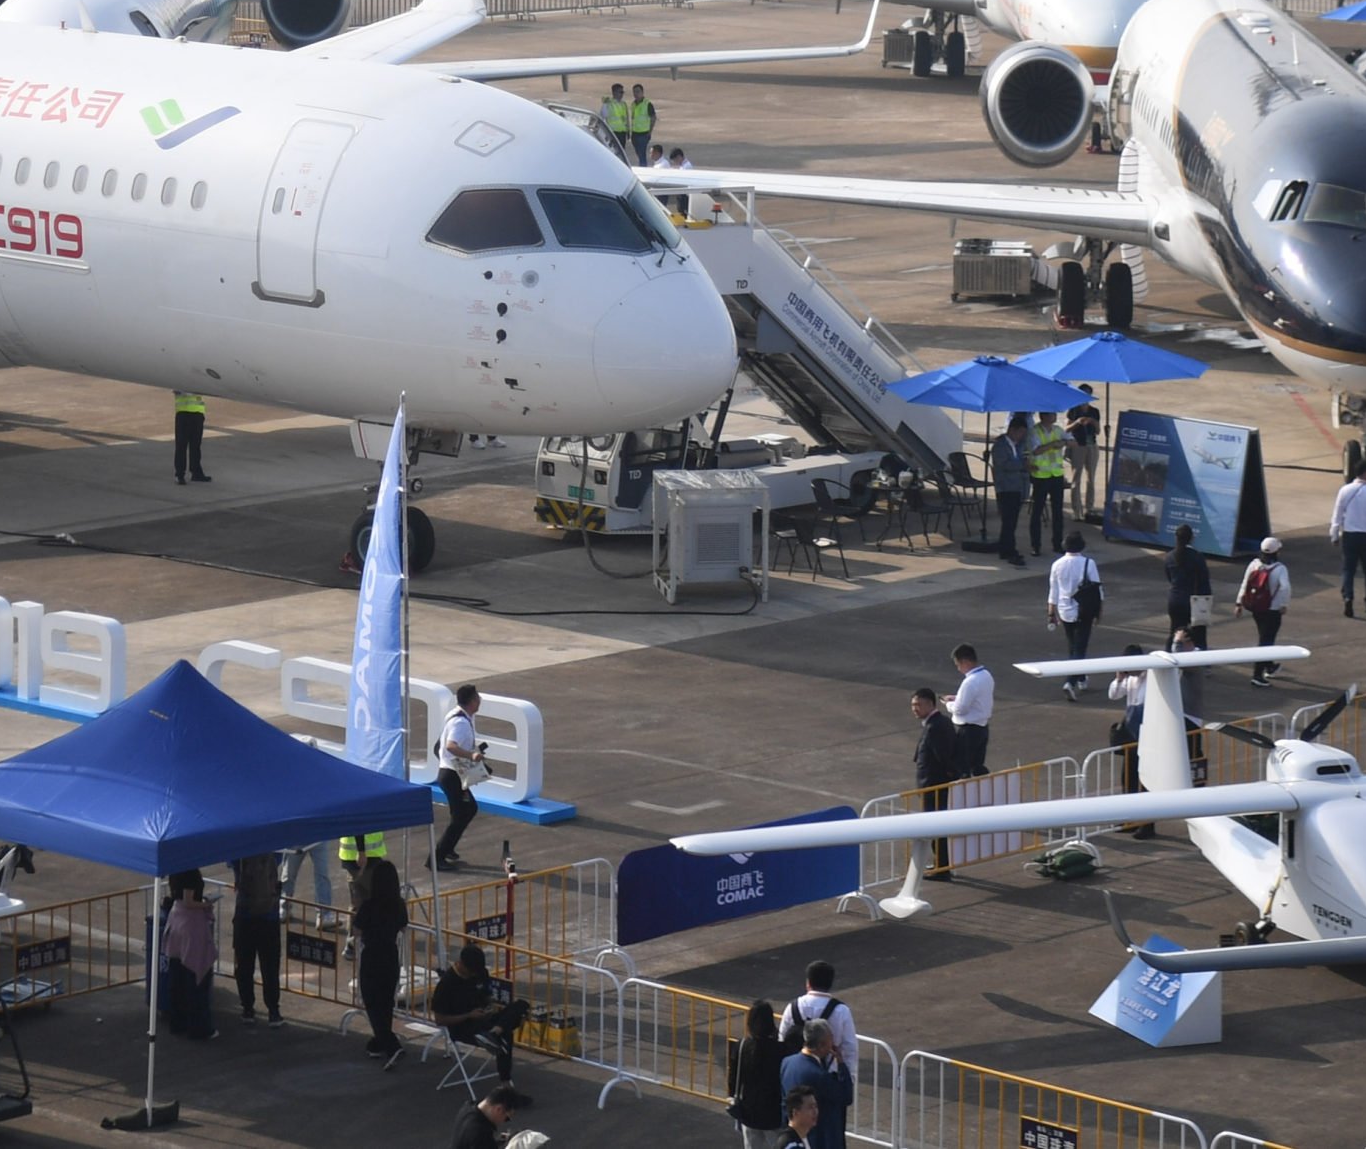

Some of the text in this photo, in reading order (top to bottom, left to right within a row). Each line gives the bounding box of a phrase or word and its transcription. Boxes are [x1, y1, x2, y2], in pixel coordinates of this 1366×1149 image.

[716, 870, 764, 892] 中国商飞
[716, 885, 765, 906] COMAC
[1312, 904, 1353, 929] TENGDEN
